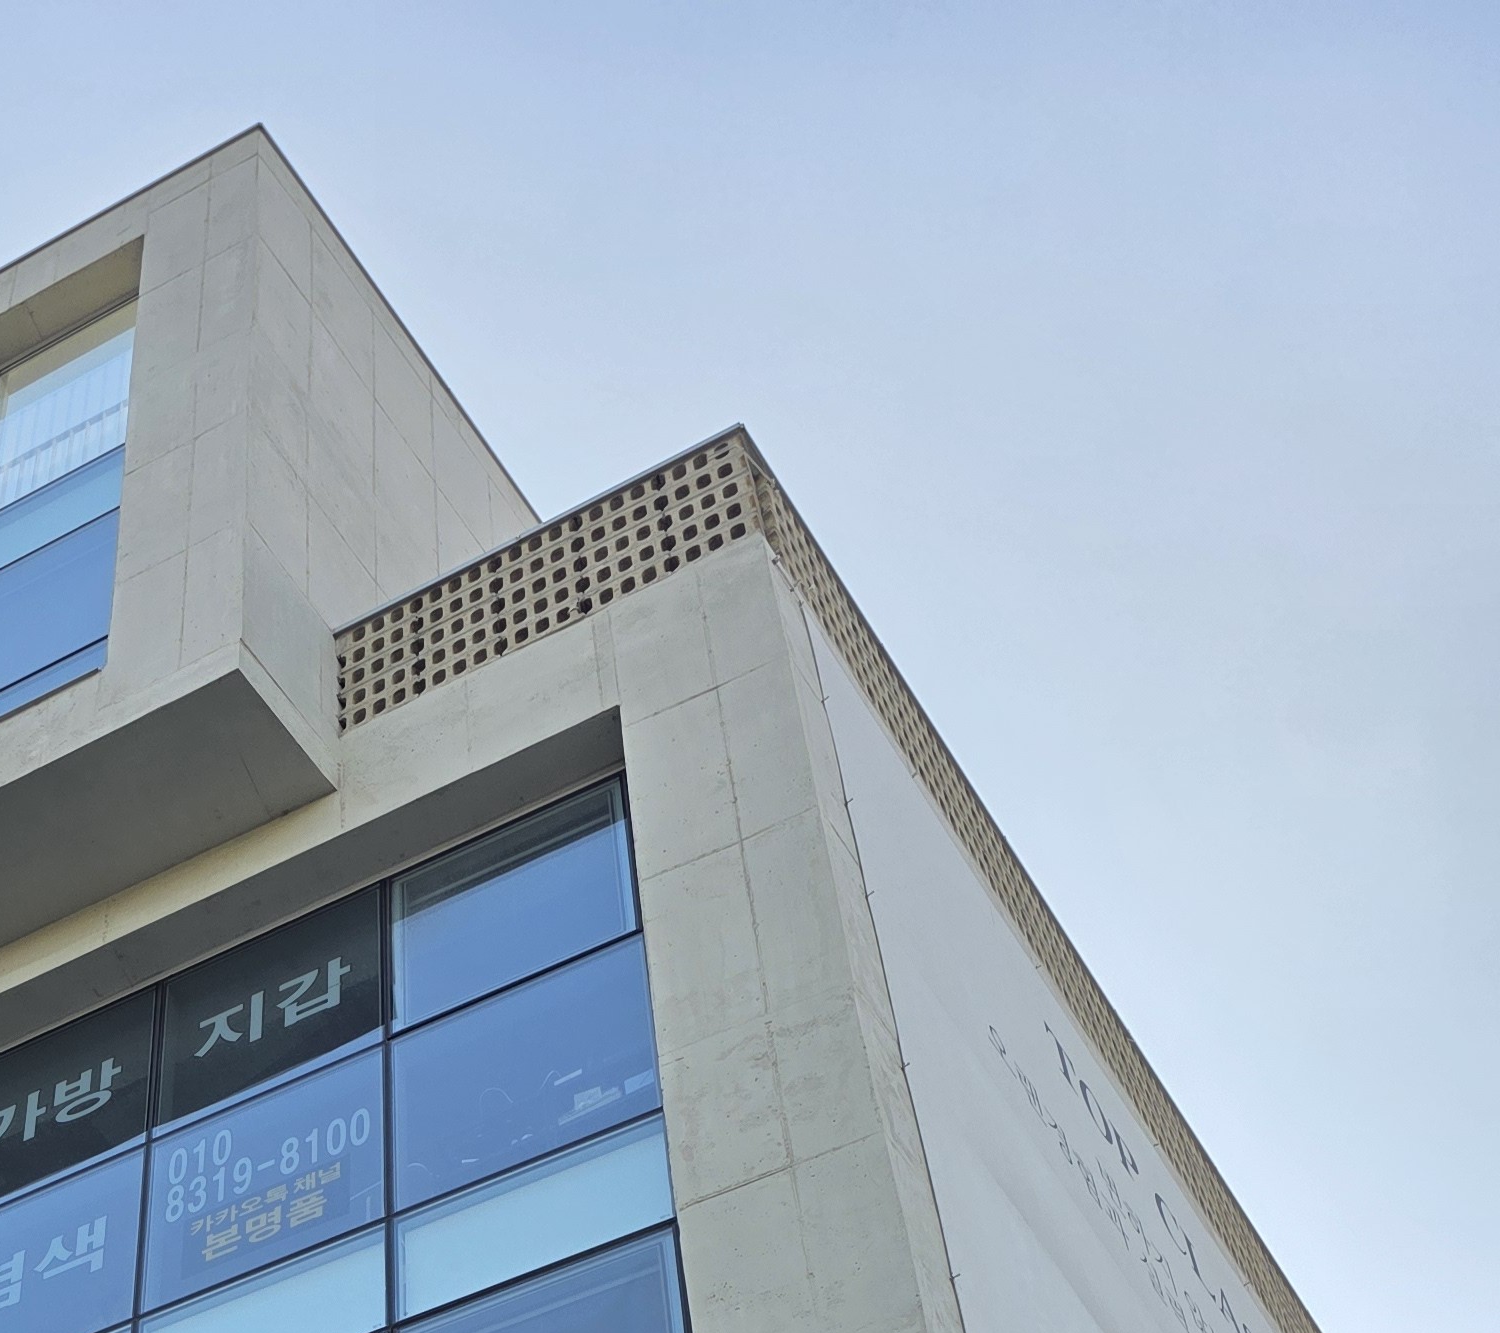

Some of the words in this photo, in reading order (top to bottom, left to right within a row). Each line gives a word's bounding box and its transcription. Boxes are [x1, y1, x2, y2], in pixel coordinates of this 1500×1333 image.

[194, 956, 352, 1058] 지갑
[1044, 1020, 1139, 1181] TOP
[165, 1108, 370, 1222] 8319-8100
[168, 1129, 232, 1185] 010
[190, 1184, 288, 1236] 카카오톡
[294, 1162, 341, 1194] 채널
[201, 1189, 327, 1262] 본명품
[1096, 1156, 1178, 1298] 변하지
